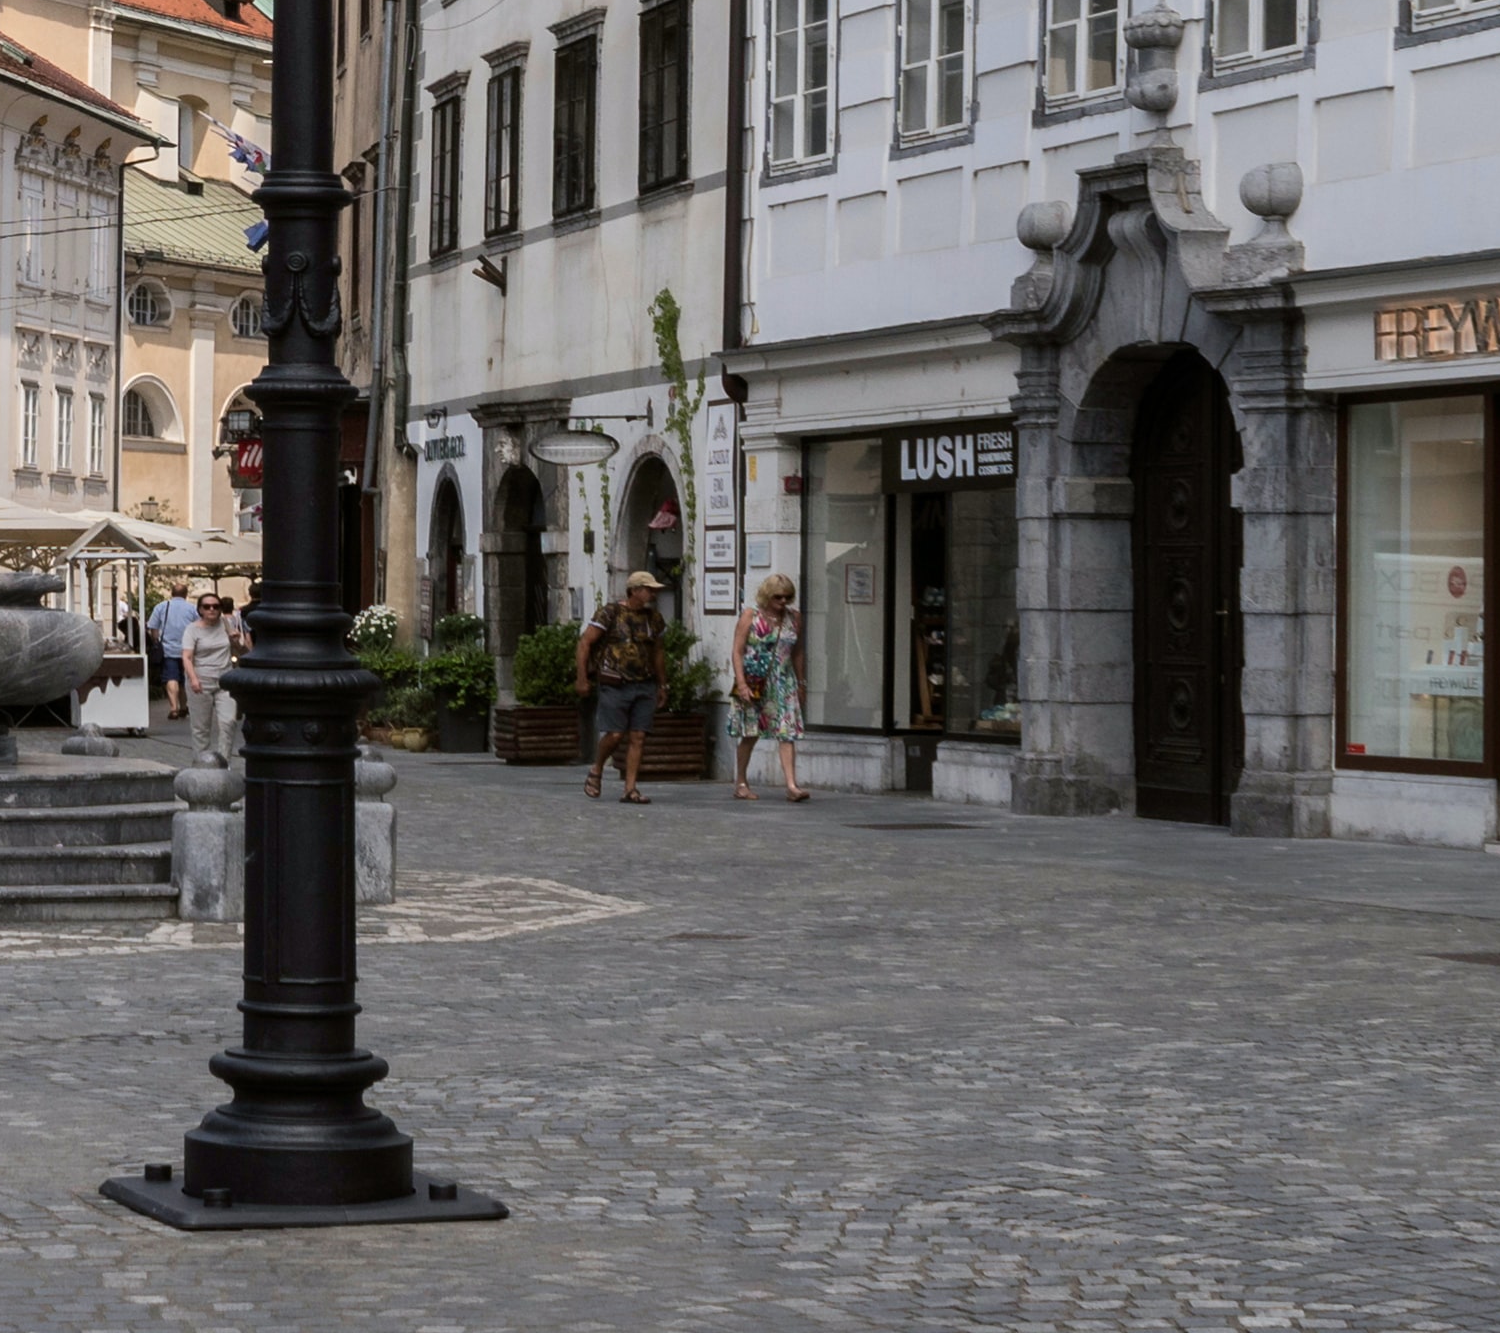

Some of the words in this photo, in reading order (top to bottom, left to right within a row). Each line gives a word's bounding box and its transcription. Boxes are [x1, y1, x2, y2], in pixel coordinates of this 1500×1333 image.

[240, 444, 263, 468] ill
[901, 435, 975, 481] LUSH
[977, 431, 1013, 450] FRESH
